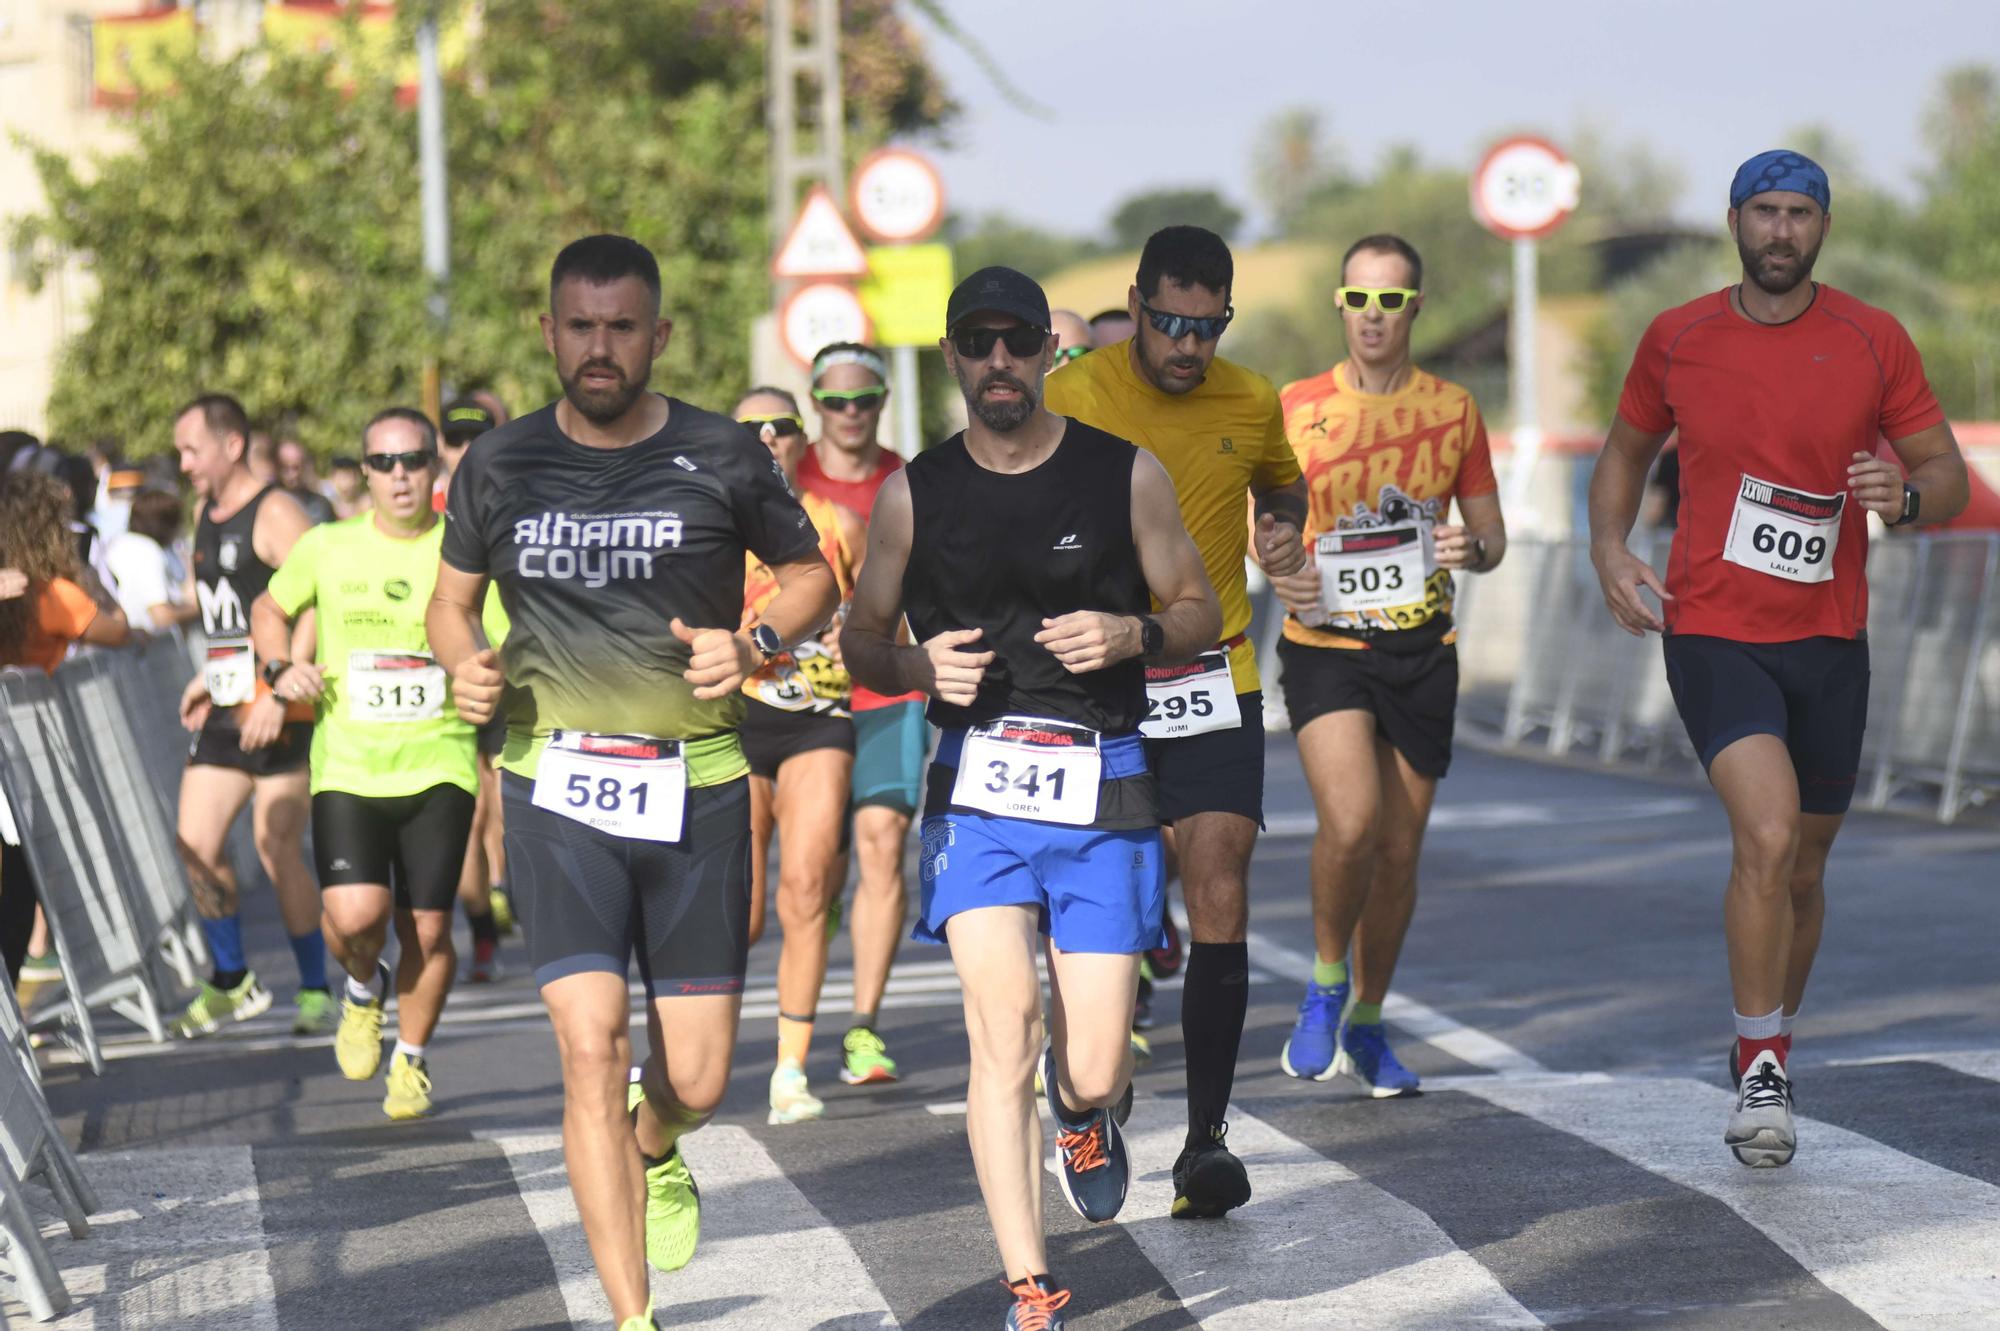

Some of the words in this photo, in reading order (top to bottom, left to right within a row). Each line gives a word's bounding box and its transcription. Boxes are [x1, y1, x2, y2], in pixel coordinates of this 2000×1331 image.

[1743, 479, 1773, 504] XXVIII
[1752, 523, 1826, 565] 609
[1338, 565, 1403, 594] 503
[1770, 561, 1800, 575] LALEX
[368, 685, 425, 707] 313
[1144, 690, 1213, 721] 295
[1166, 724, 1189, 733] JUMI
[984, 760, 1066, 800] 341
[565, 773, 649, 815] 581
[1006, 803, 1041, 813] LOREN
